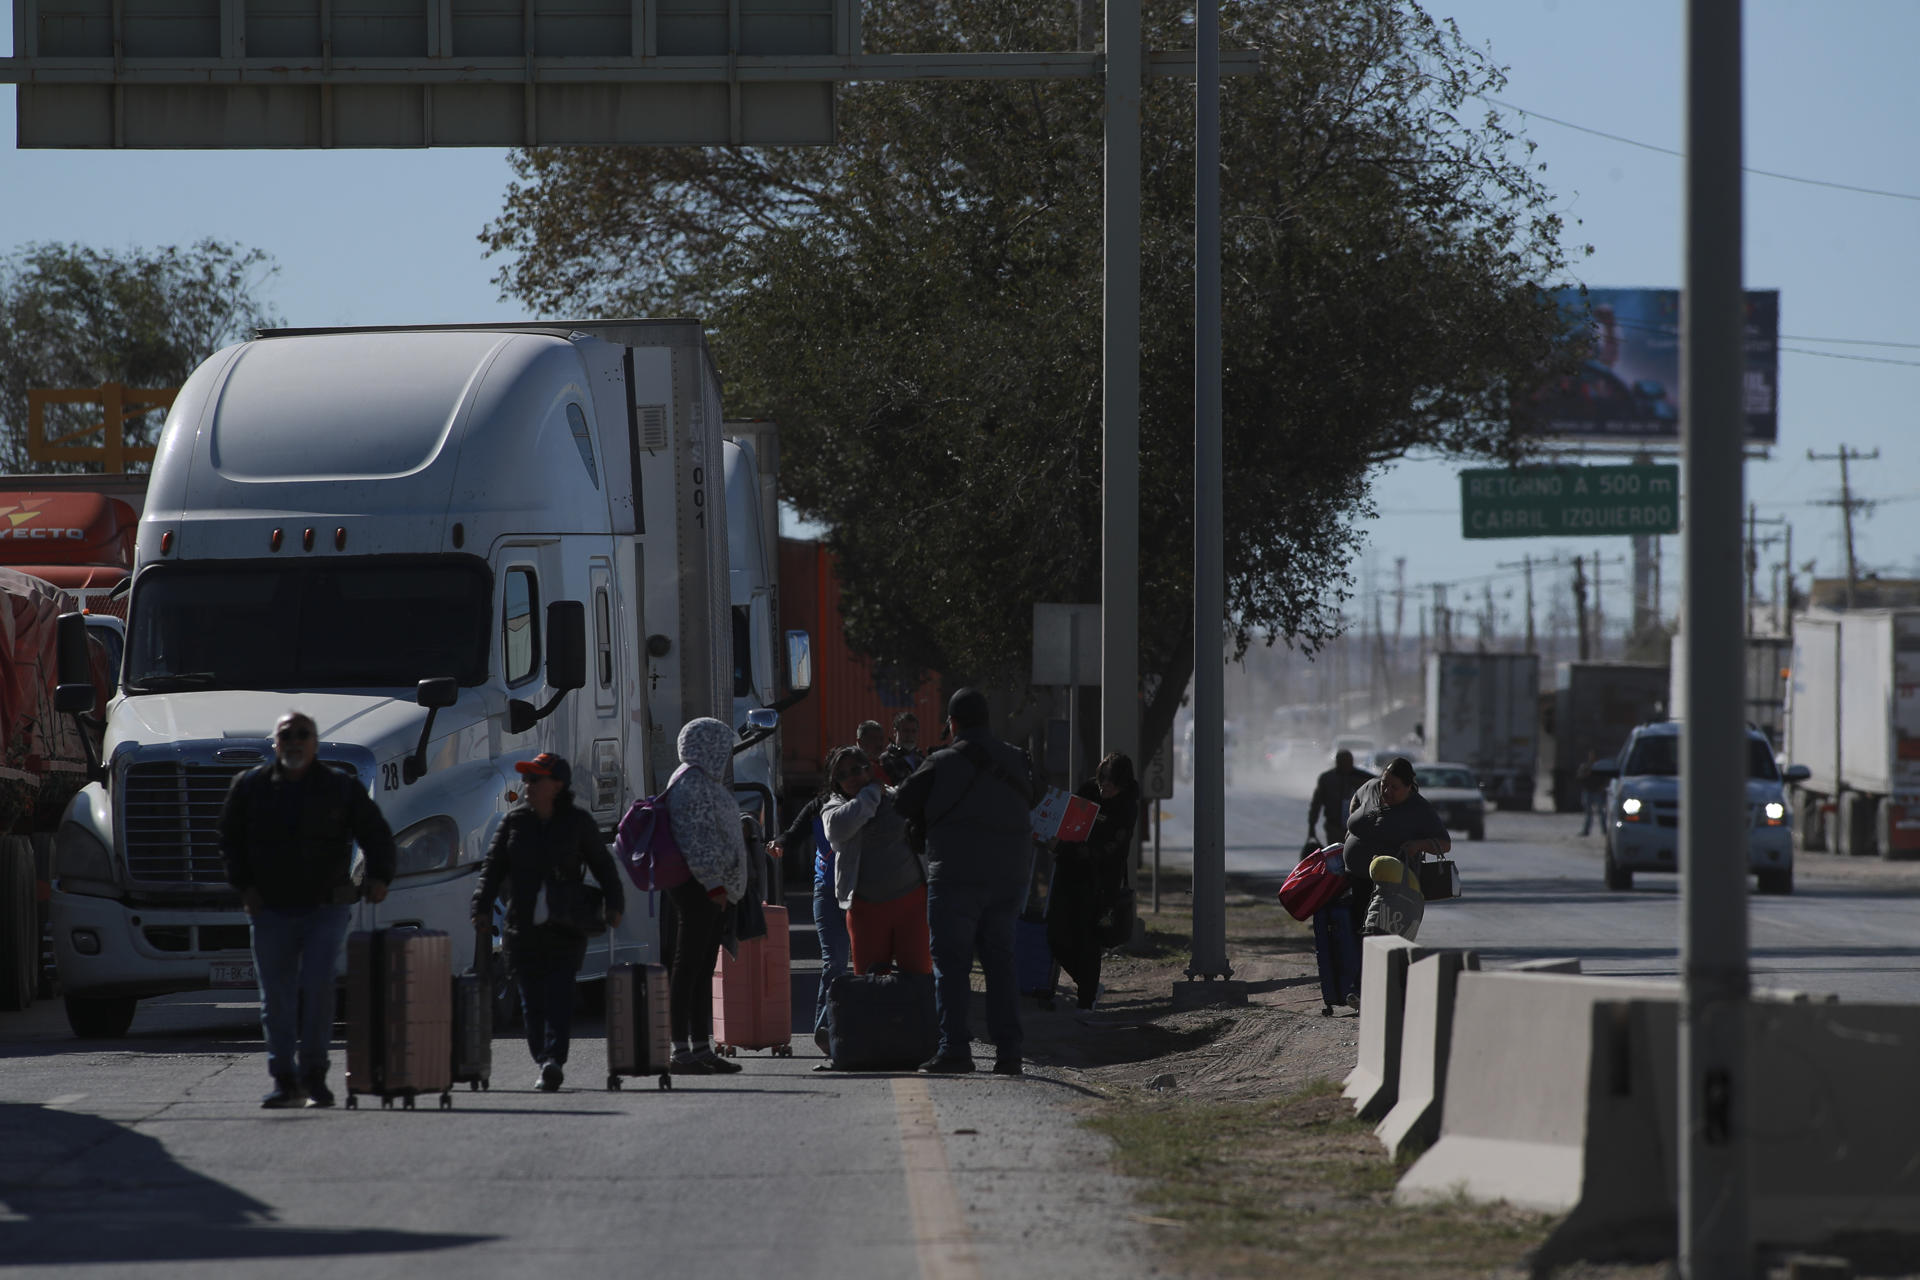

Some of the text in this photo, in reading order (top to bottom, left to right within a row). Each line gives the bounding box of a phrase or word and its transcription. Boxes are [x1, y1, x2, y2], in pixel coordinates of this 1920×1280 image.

[693, 467, 704, 529] 001
[1470, 474, 1672, 498] RETORNO A 500 m
[1471, 505, 1672, 530] CARRIL IZQUIERDO
[382, 762, 400, 791] 28
